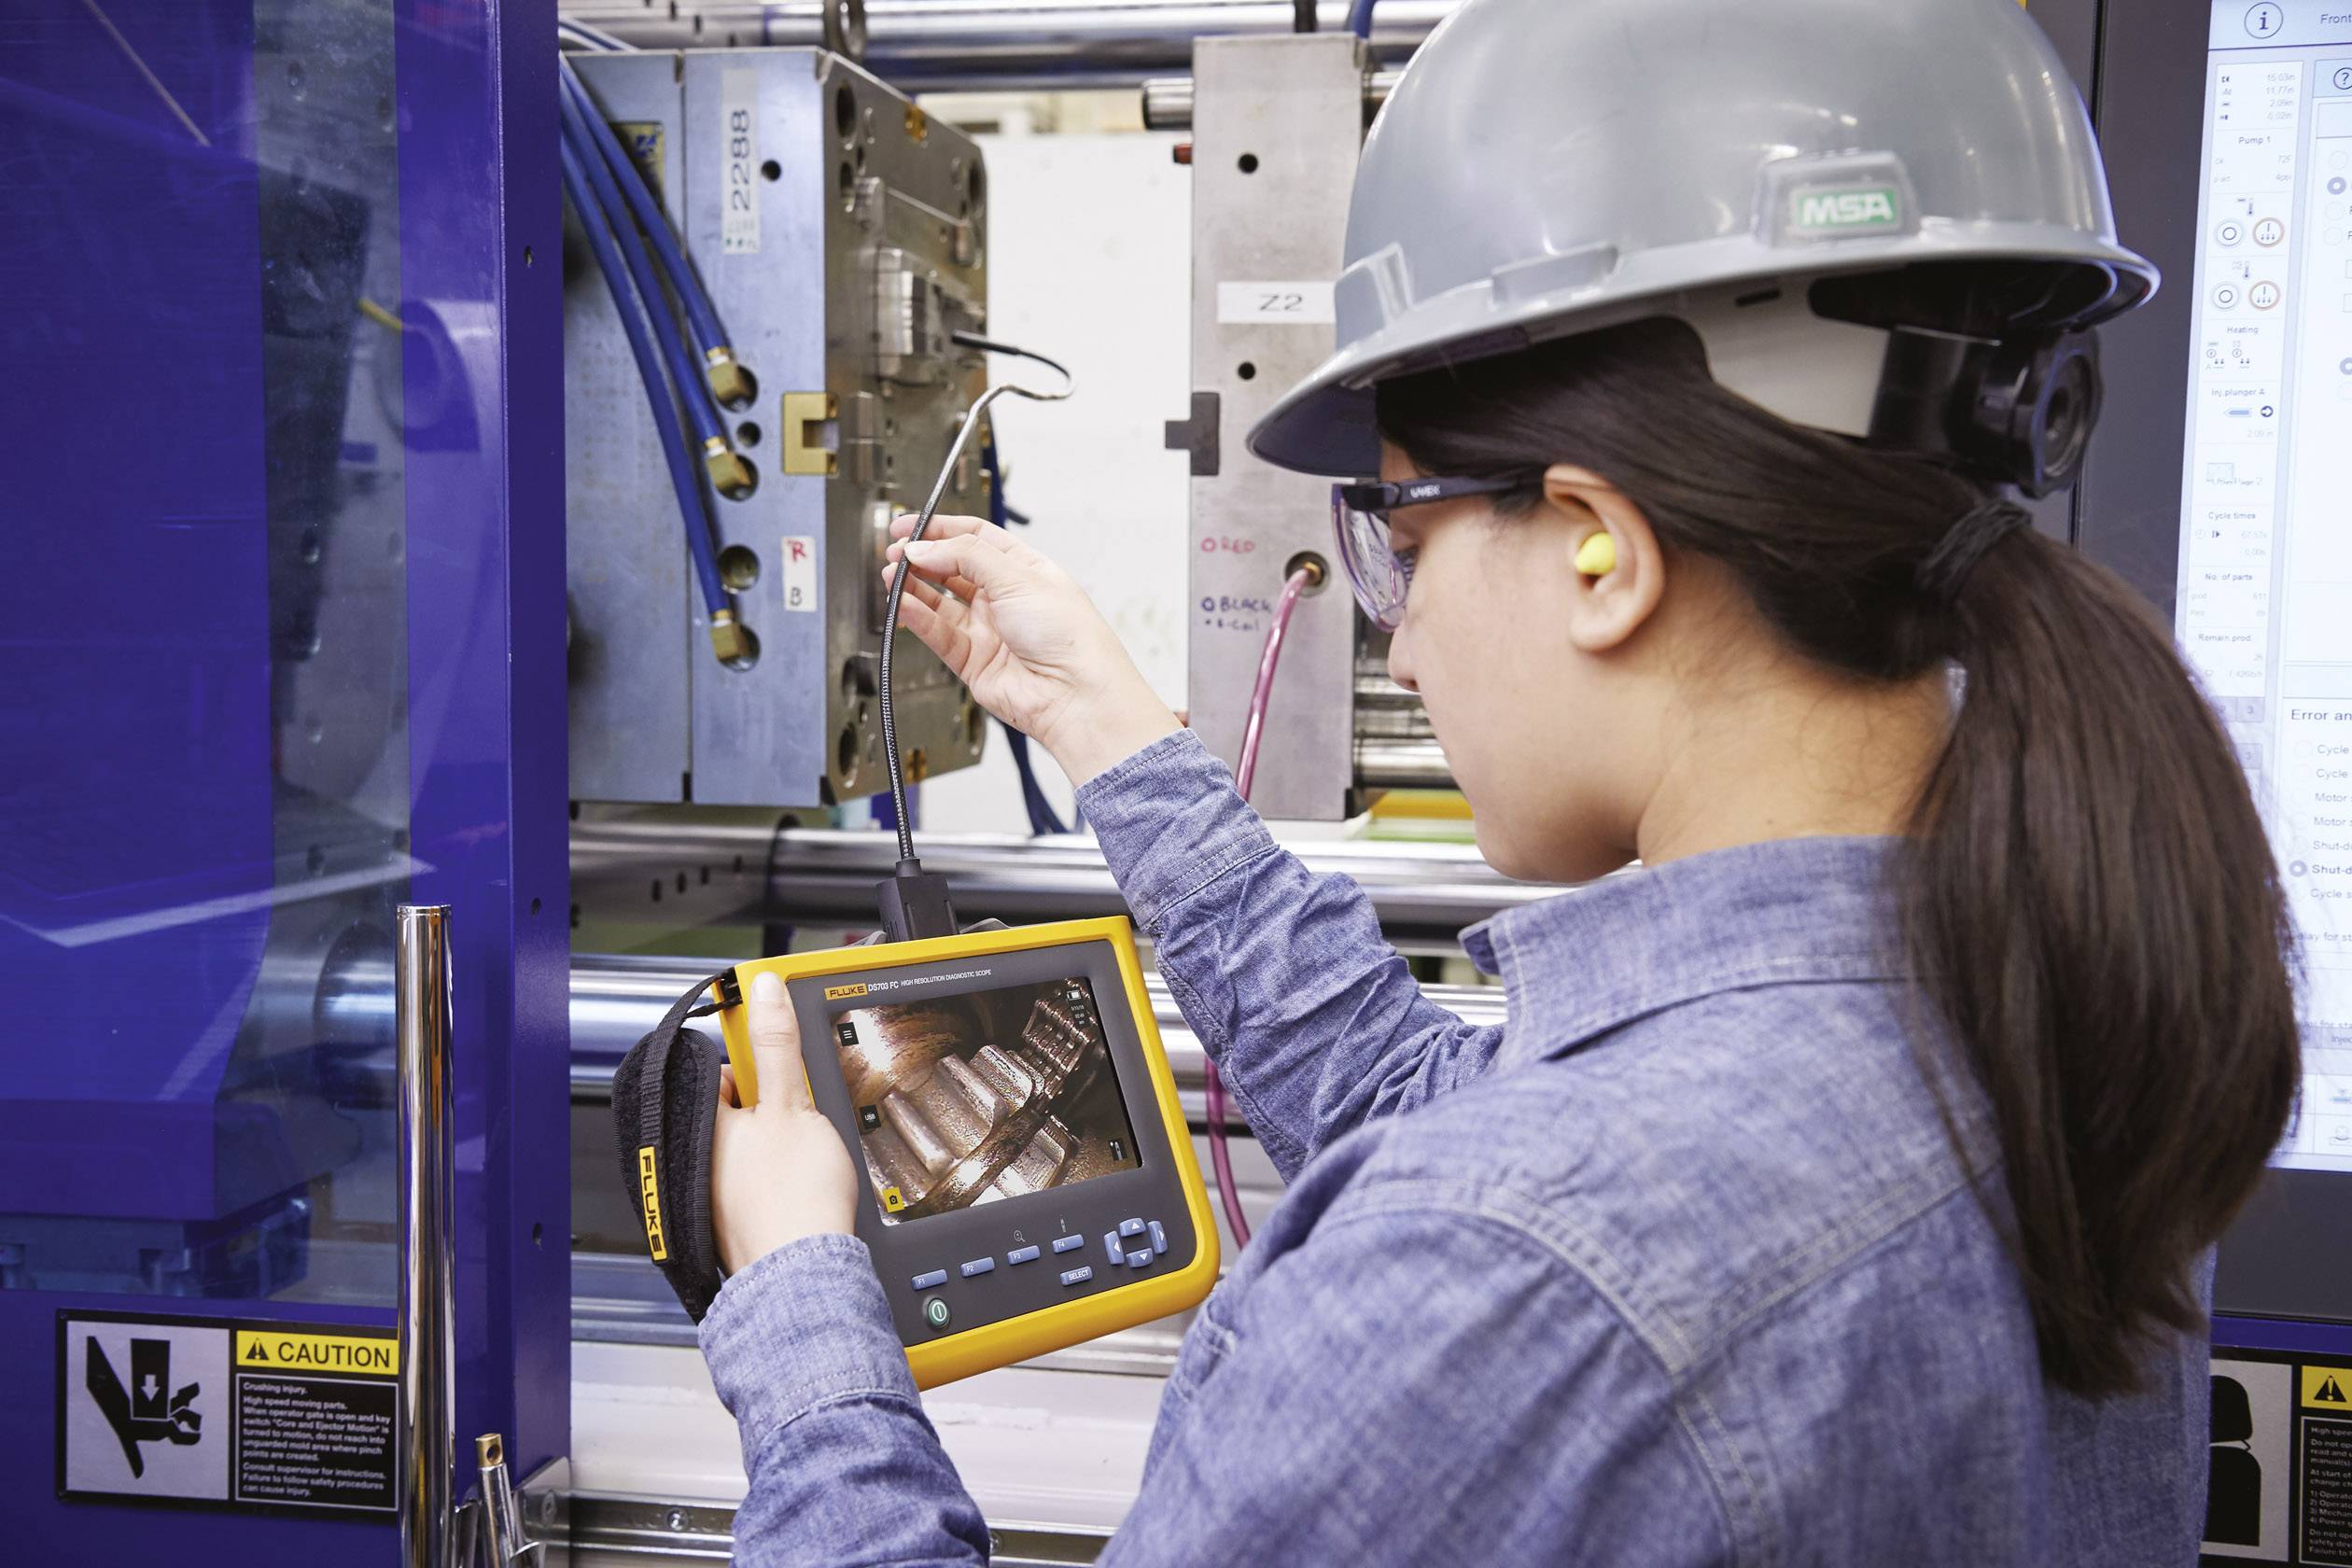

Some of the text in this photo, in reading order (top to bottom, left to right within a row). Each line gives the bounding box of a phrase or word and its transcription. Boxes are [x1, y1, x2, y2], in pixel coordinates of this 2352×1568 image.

[2238, 136, 2263, 146] Pump
[730, 109, 750, 212] 2288
[1802, 193, 1893, 225] MSA
[1260, 293, 1303, 312] Z2
[2227, 327, 2260, 335] Heating
[2225, 388, 2256, 397] plunger
[2208, 511, 2231, 522] Cycle
[788, 541, 806, 562] R
[2221, 572, 2231, 581] of
[790, 587, 803, 607] B
[1221, 595, 1272, 613] BLACK
[2247, 706, 2254, 714] 3
[2291, 709, 2329, 721] Error
[2317, 744, 2349, 756] Cycle
[2316, 768, 2348, 780] Cycle
[2315, 792, 2347, 803] Motor
[2314, 817, 2346, 826] Motor
[2310, 888, 2342, 900] Cycle
[829, 986, 865, 998] FLUKE
[868, 983, 889, 992] DS703
[889, 981, 900, 989] FC
[914, 974, 945, 986] RESOLUTION
[945, 971, 975, 981] DIAGNOSTIC
[975, 969, 992, 977] SCOPE
[642, 1155, 663, 1253] FLUKE
[1068, 1269, 1089, 1281] SELECT
[278, 1341, 390, 1368] CAUTION
[244, 1382, 307, 1394] Crushing injury.
[244, 1396, 262, 1406] High
[265, 1398, 290, 1407] speed
[291, 1399, 321, 1409] moving
[244, 1407, 267, 1415] When
[269, 1409, 303, 1418] operator
[375, 1414, 390, 1424] key
[244, 1418, 271, 1426] switch
[315, 1421, 344, 1431] Ejector
[244, 1428, 270, 1436] turned
[244, 1439, 287, 1449] unguarded
[358, 1447, 383, 1455] pinch
[244, 1462, 274, 1471] Consult
[276, 1465, 319, 1474] supervisor
[244, 1473, 271, 1481] Failure
[284, 1476, 308, 1484] follow
[310, 1477, 335, 1488] safety
[337, 1479, 384, 1490] procedures
